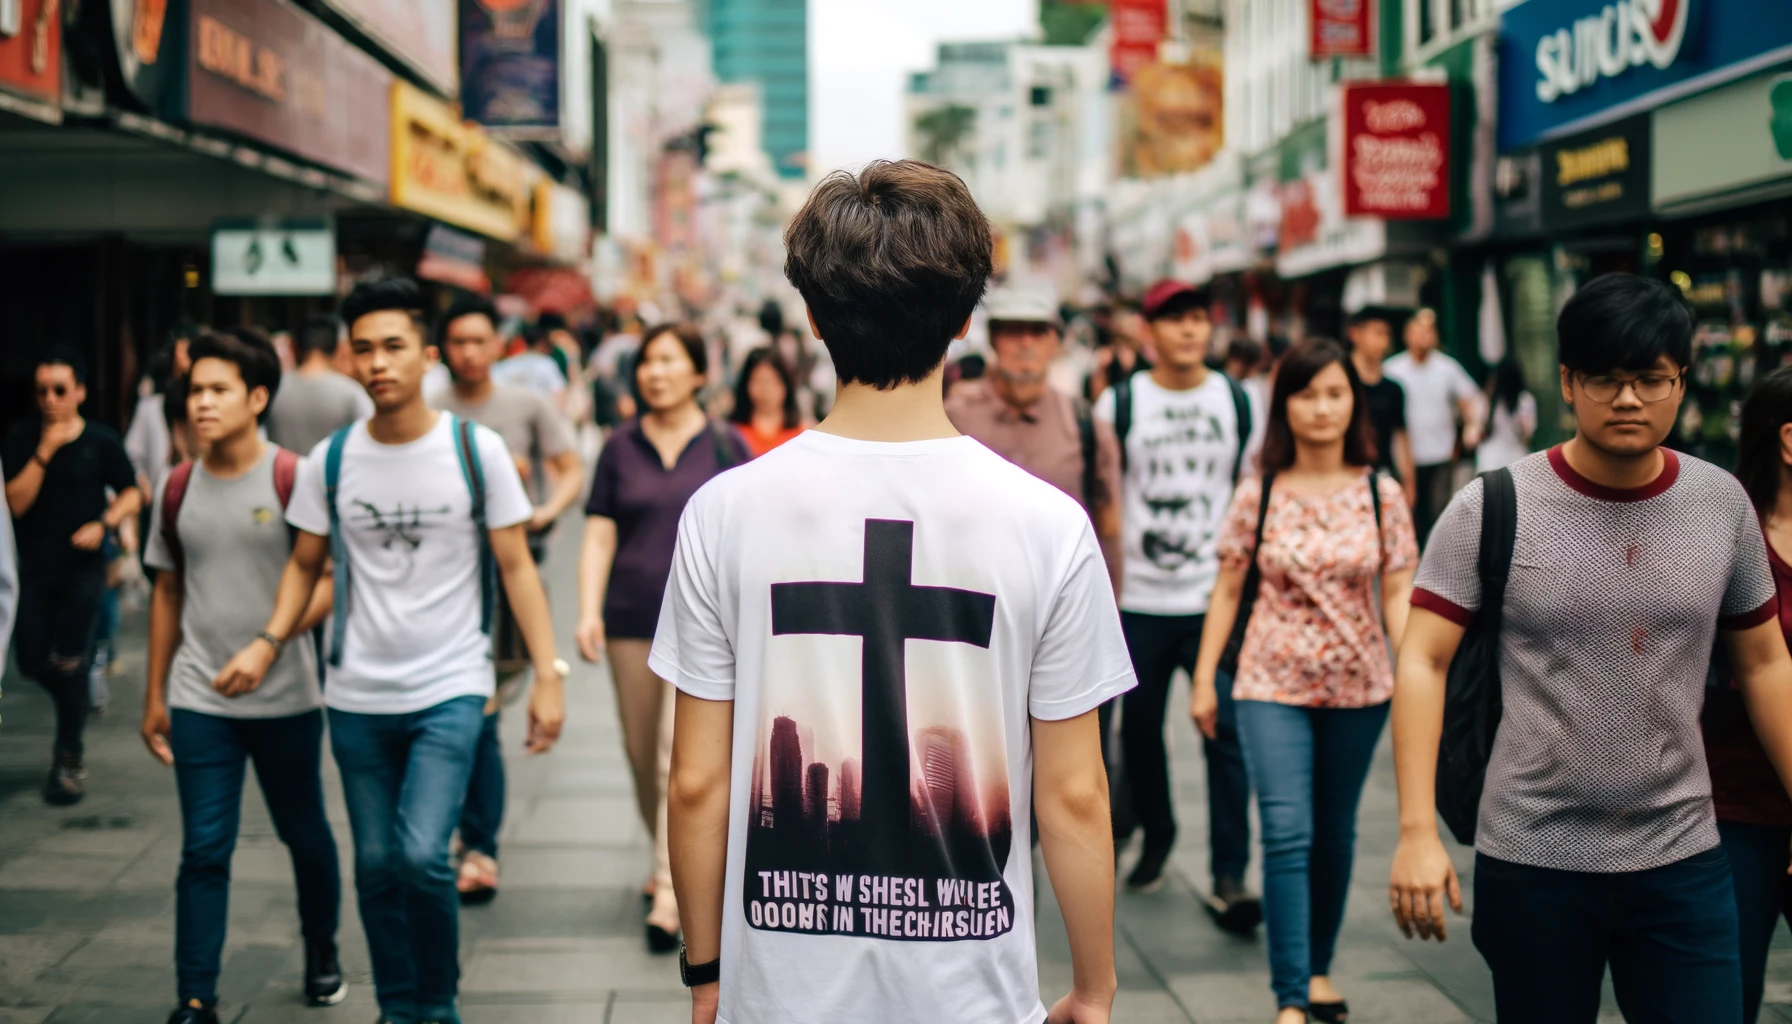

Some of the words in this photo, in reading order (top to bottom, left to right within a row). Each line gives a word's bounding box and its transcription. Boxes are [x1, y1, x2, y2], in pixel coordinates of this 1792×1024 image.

[758, 871, 829, 902] THIT'S
[835, 874, 854, 903] W
[858, 875, 930, 907] SHESL
[832, 904, 854, 932] IN
